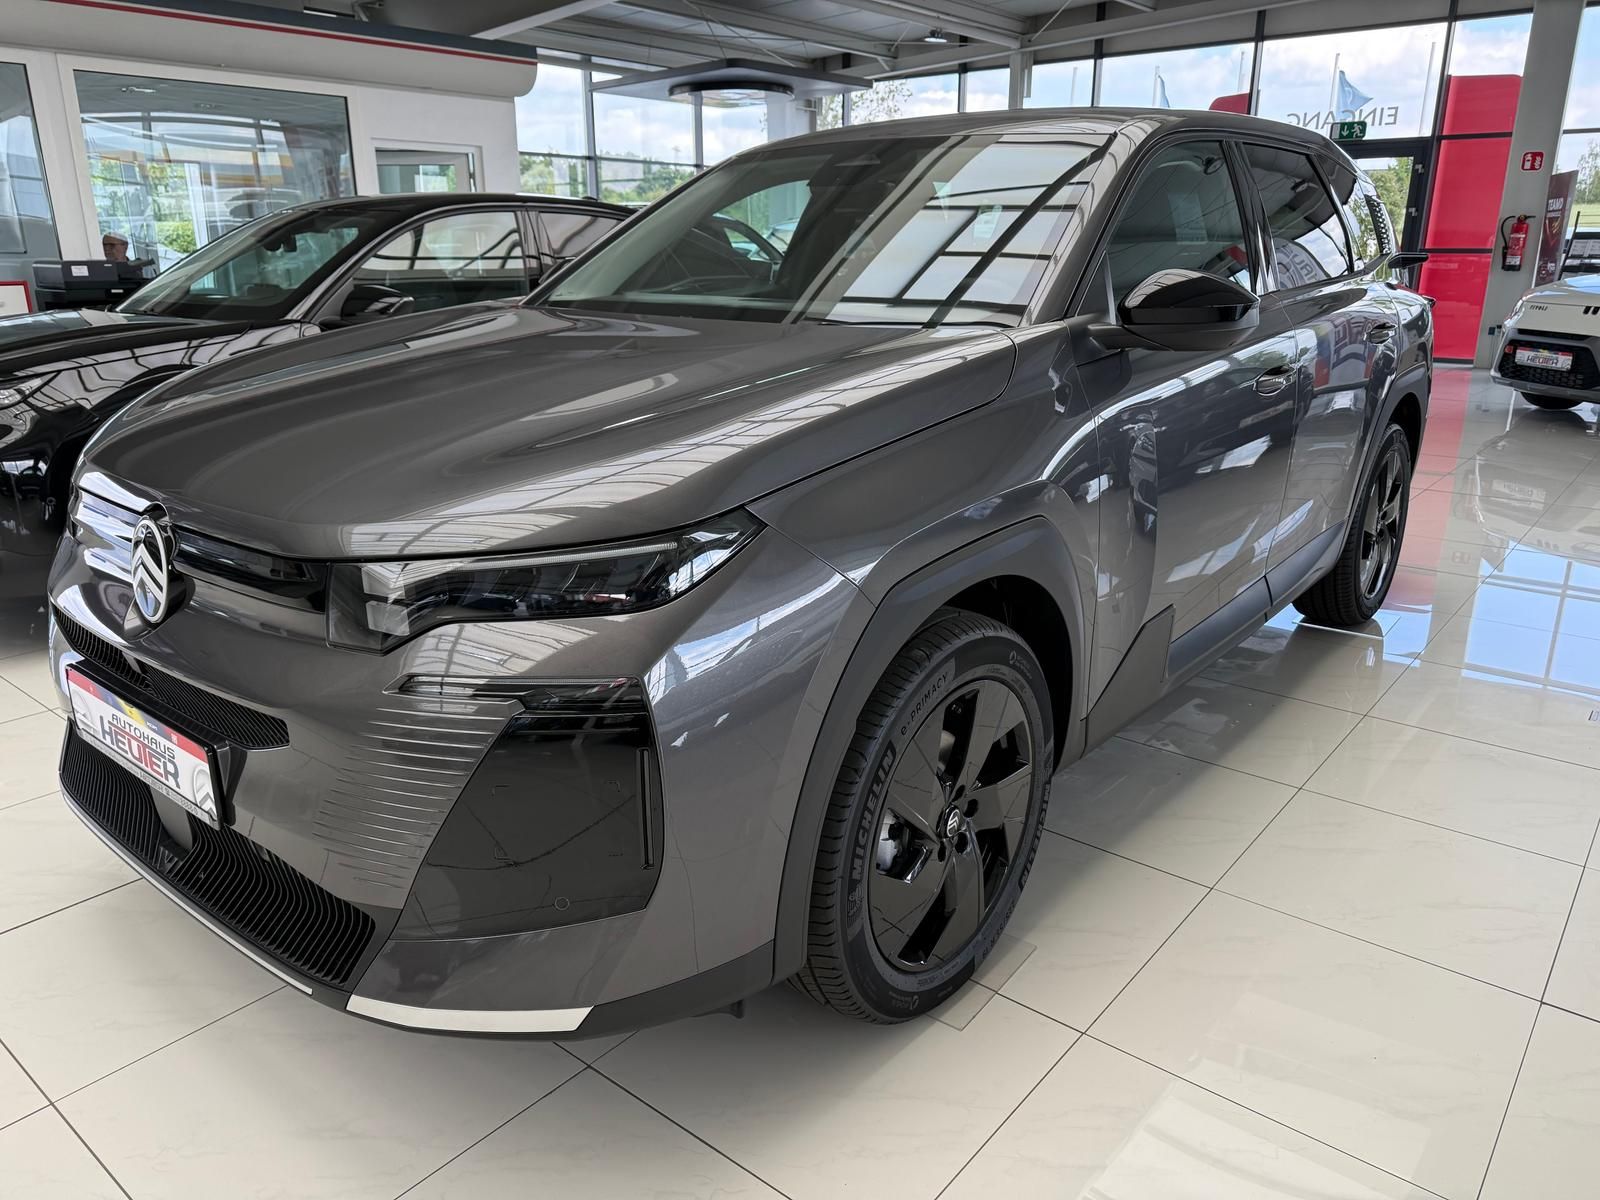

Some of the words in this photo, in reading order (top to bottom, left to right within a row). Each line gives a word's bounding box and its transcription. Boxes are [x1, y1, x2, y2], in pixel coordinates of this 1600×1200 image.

[100, 715, 181, 790] HEUTER
[111, 713, 176, 760] AUTOHAUS
[852, 748, 895, 881] MICHELIN
